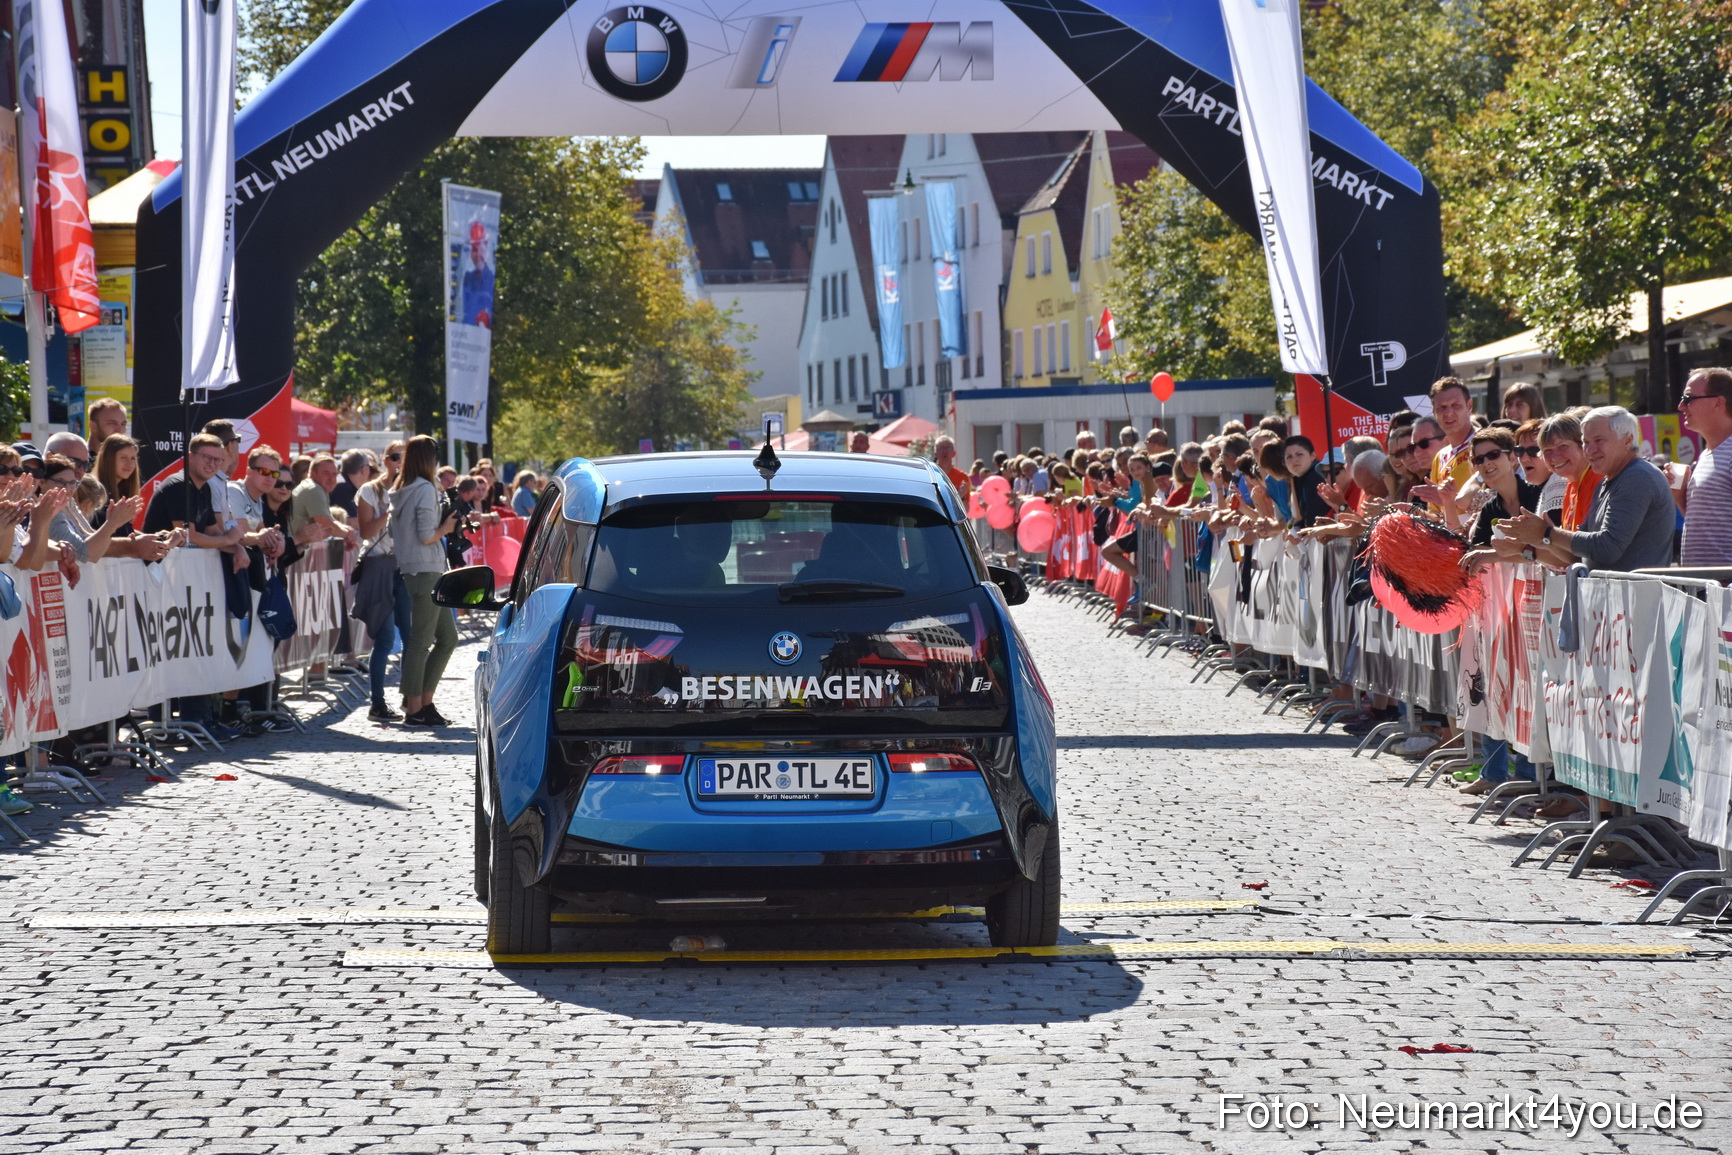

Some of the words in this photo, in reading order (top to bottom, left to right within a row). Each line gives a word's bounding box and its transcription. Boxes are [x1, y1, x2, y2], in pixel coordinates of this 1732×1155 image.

[595, 6, 677, 34] BMW
[271, 80, 415, 181] NEUMARKT
[1353, 416, 1373, 426] THE
[169, 431, 184, 441] TH
[1338, 427, 1354, 437] 100
[1356, 424, 1389, 435] YEARS
[154, 441, 170, 451] 100
[171, 442, 184, 452] YE
[663, 673, 901, 706] „BESENWAGEN“
[970, 676, 992, 692] i3
[704, 780, 711, 789] D
[717, 762, 772, 789] PAR
[792, 762, 828, 789] TL
[834, 762, 869, 789] 4E
